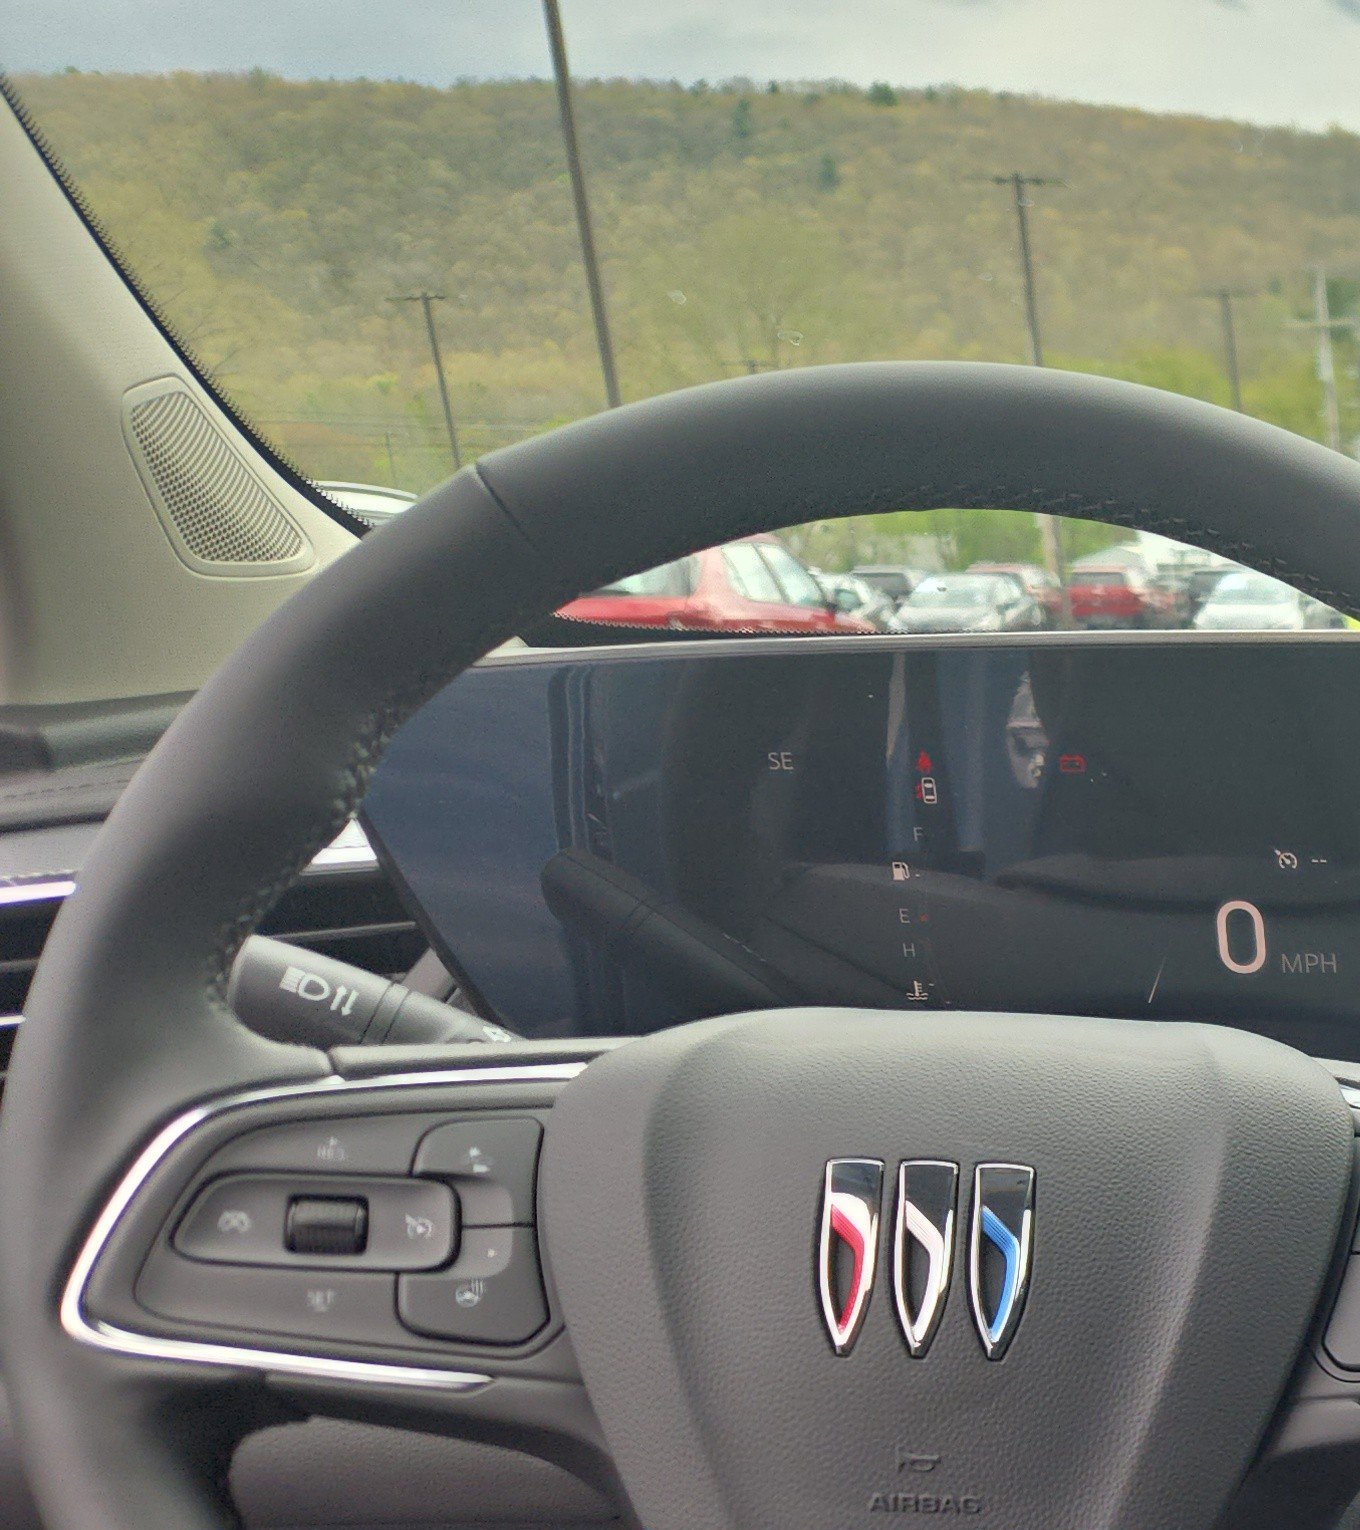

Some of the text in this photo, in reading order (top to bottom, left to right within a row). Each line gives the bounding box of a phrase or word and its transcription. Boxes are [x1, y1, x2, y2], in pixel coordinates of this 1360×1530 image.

[768, 752, 795, 770] SE
[913, 827, 925, 841] F
[900, 908, 911, 923] E
[1216, 900, 1337, 973] 0 MPH
[903, 943, 916, 957] H
[868, 1492, 982, 1514] AIRBAG
